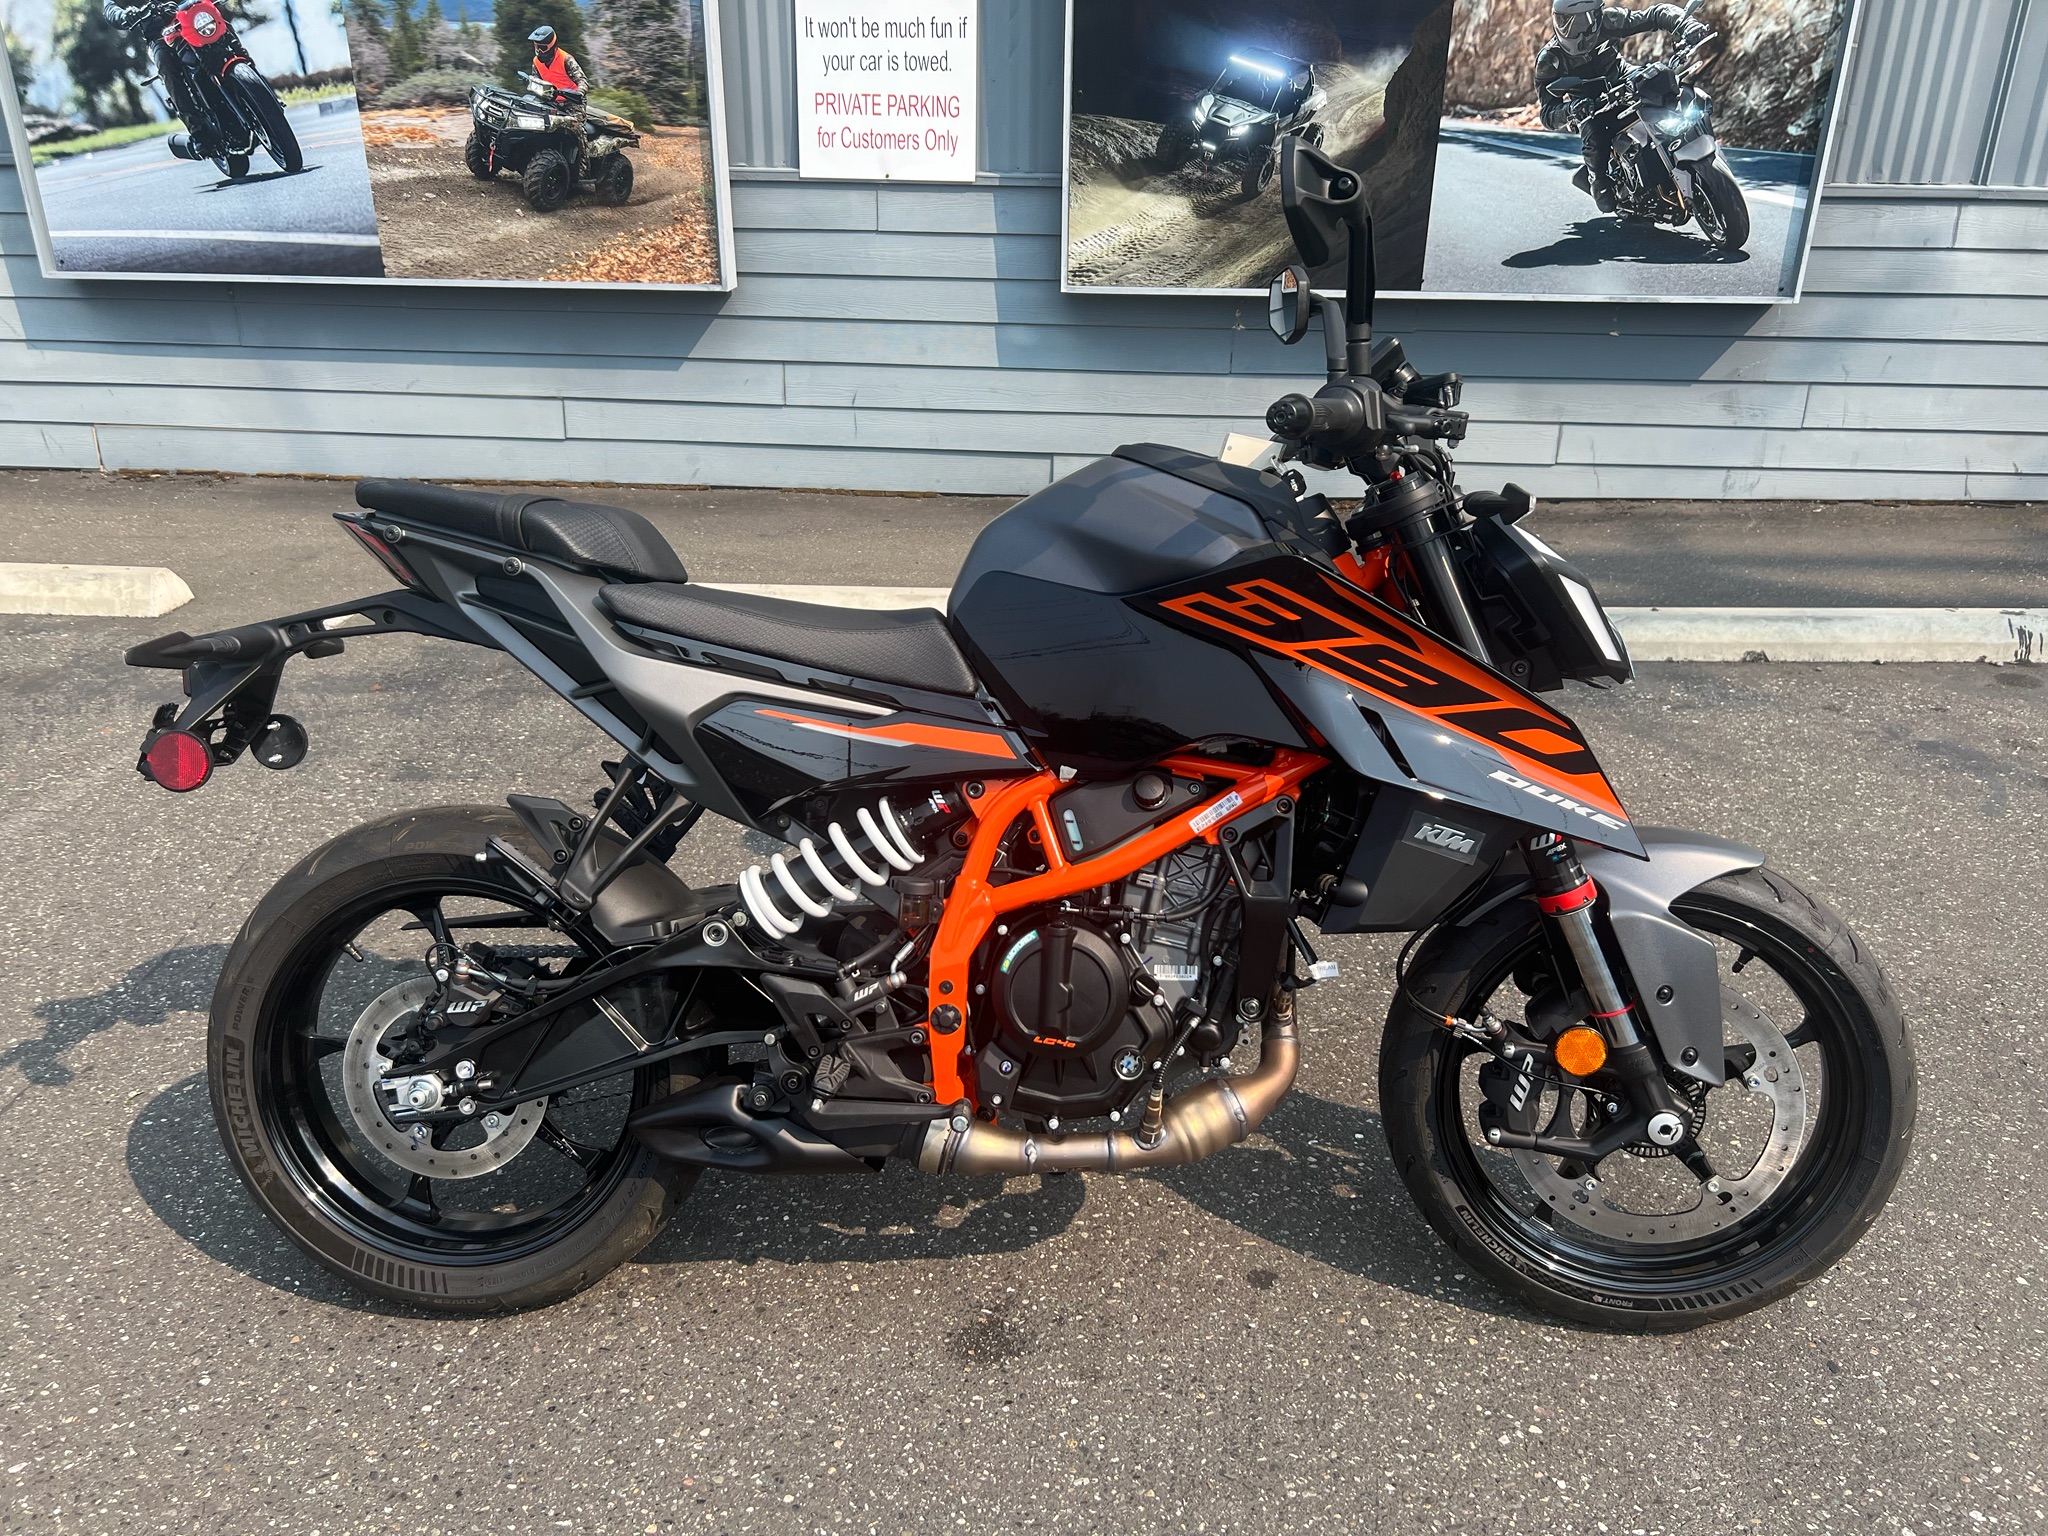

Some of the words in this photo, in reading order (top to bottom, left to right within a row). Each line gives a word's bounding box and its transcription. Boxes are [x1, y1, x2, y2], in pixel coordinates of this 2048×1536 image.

[804, 16, 814, 39] It
[818, 16, 857, 39] won't
[861, 16, 880, 39] be
[884, 17, 925, 39] much
[930, 16, 953, 39] fun
[958, 16, 968, 39] if
[822, 54, 855, 77] your
[859, 55, 883, 72] car
[887, 50, 899, 72] is
[903, 50, 952, 72] towed.
[814, 92, 882, 116] PRIVATE
[887, 94, 960, 118] PARKING
[817, 126, 837, 148] for
[841, 126, 920, 150] Customers
[924, 128, 959, 157] Only
[1487, 769, 1628, 831] DUKE
[1414, 823, 1476, 854] KTM
[854, 981, 880, 1002] WP
[446, 1000, 488, 1014] WP
[1510, 1053, 1534, 1111] WP
[226, 1048, 261, 1158] MICHELIN
[1459, 1209, 1512, 1263] MICHELIN
[1602, 1298, 1634, 1308] FRONT
